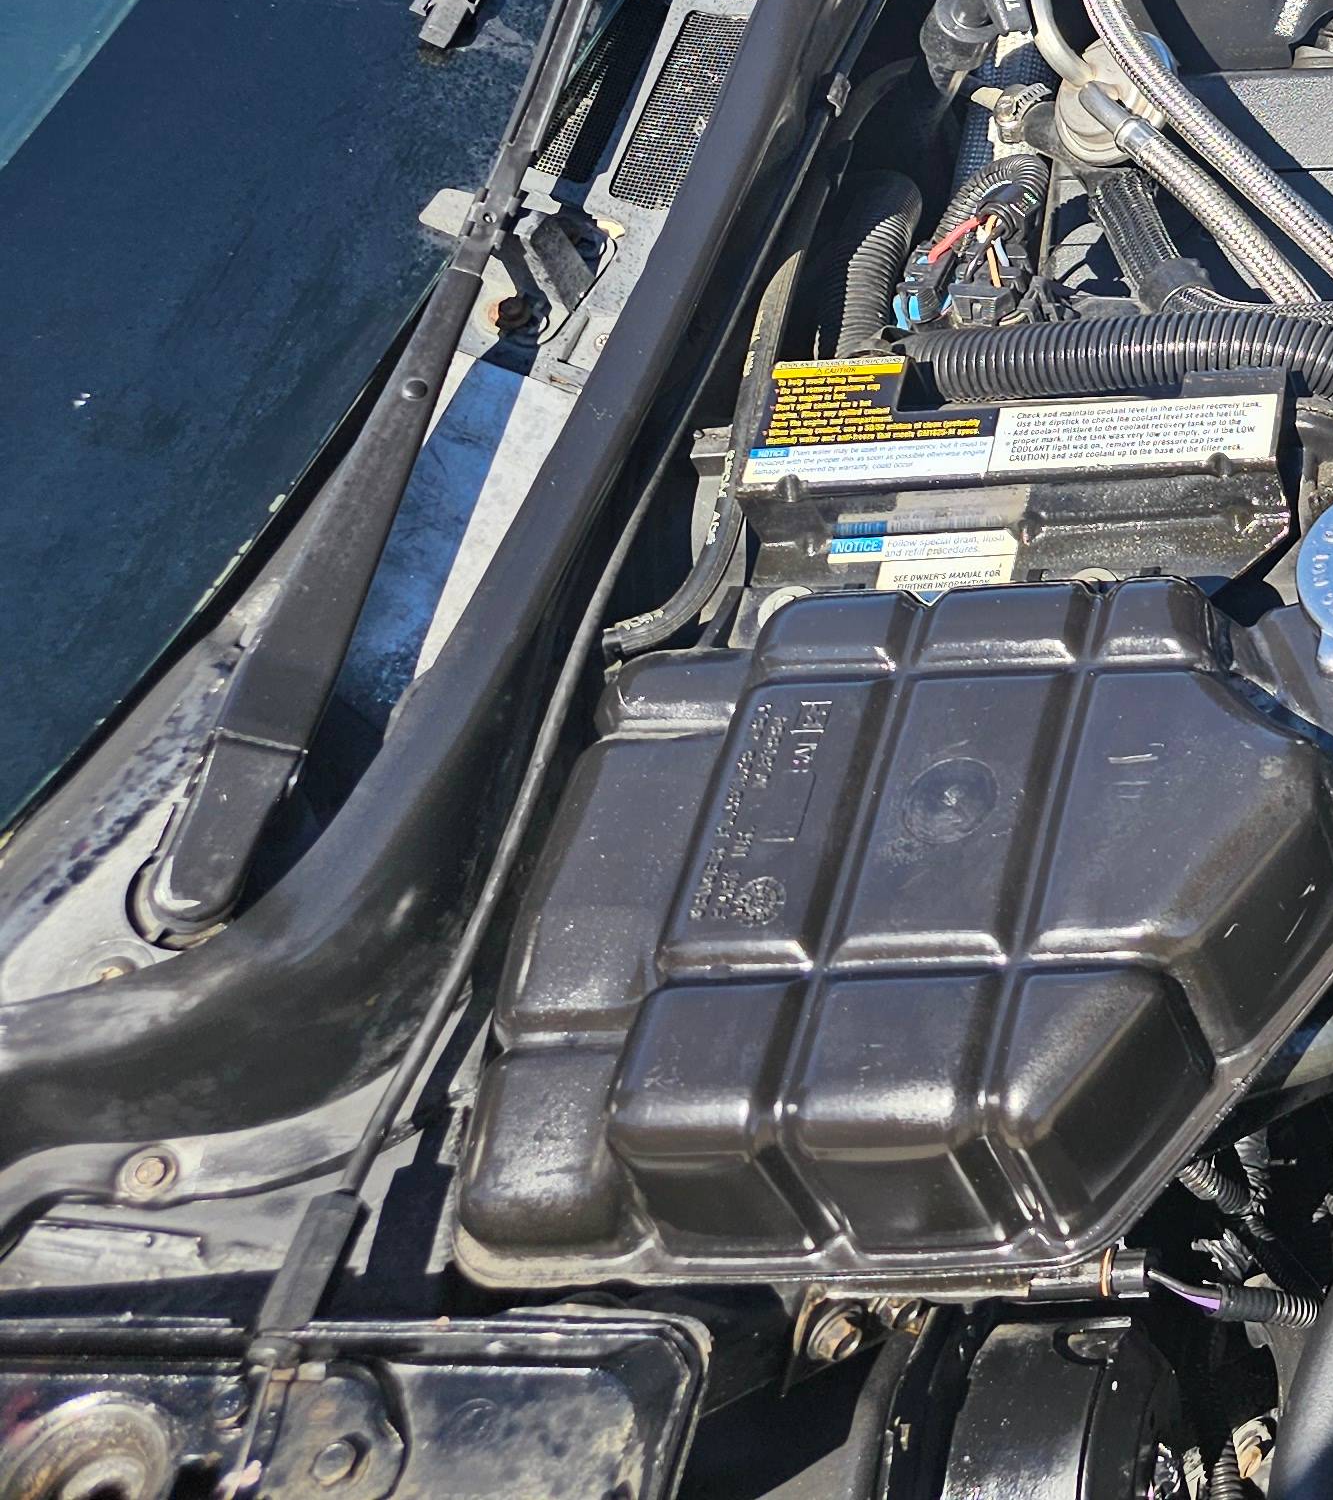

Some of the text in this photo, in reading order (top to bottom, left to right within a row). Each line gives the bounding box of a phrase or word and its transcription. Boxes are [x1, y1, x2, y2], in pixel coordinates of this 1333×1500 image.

[824, 366, 856, 374] CAUTION
[1016, 411, 1040, 420] Check
[1096, 406, 1125, 415] coolant
[1128, 405, 1148, 414] level
[1174, 402, 1204, 411] coolant
[1206, 400, 1240, 410] recovery
[1012, 428, 1028, 436] Add
[1030, 426, 1059, 435] coolant
[1094, 424, 1102, 432] to
[1119, 422, 1149, 431] coolant
[1151, 420, 1185, 429] recovery
[1206, 418, 1216, 426] up
[1033, 419, 1045, 427] the
[1048, 417, 1079, 426] dipstick
[1081, 416, 1089, 424] to
[1091, 415, 1114, 424] check
[1131, 413, 1160, 422] coolant
[1162, 411, 1182, 420] level
[1010, 444, 1050, 453] COOLANT
[1105, 439, 1135, 448] remove
[1152, 437, 1187, 446] pressure
[1189, 436, 1204, 444] cap
[887, 538, 917, 548] Follow
[919, 536, 951, 549] special
[884, 548, 901, 558] and
[904, 547, 925, 557] refill
[893, 574, 908, 582] SEE
[949, 570, 982, 580] MANUAL
[984, 569, 1001, 578] FOR
[1313, 553, 1330, 588] NOT
